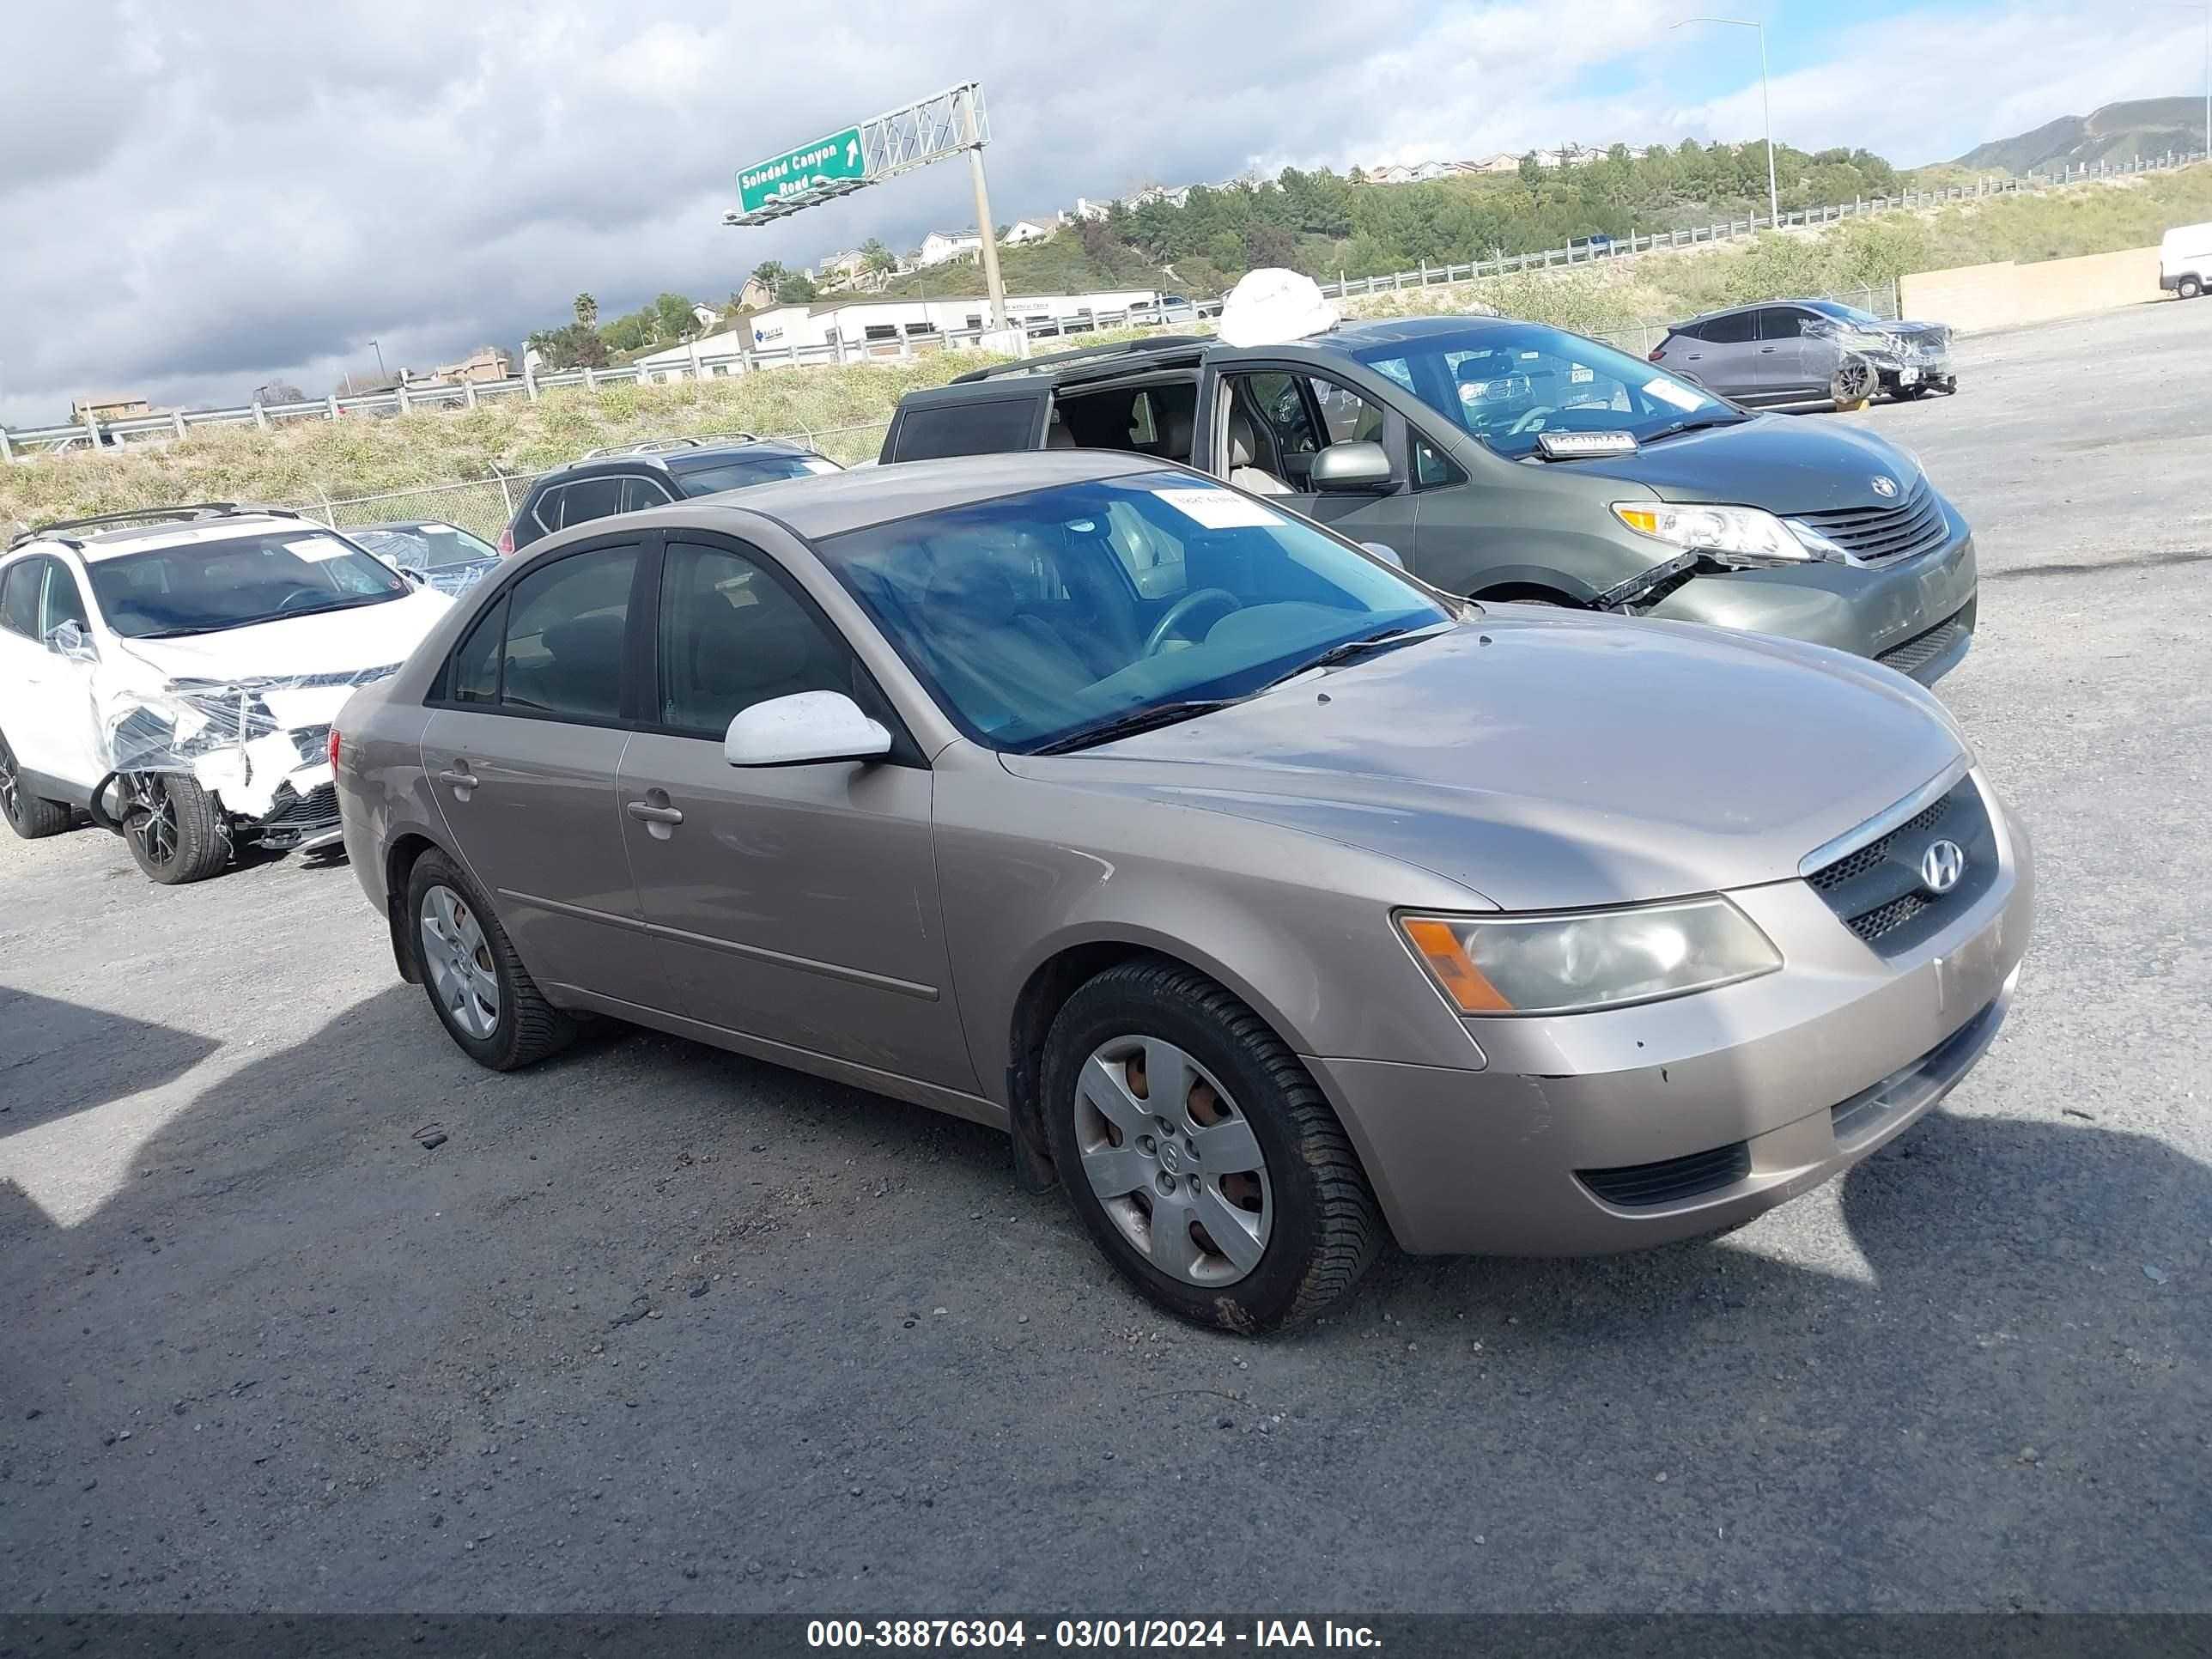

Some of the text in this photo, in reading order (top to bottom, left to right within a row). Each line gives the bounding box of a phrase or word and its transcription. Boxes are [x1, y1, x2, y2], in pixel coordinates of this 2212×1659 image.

[741, 143, 837, 190] Soledad Canyon
[779, 173, 809, 196] Road
